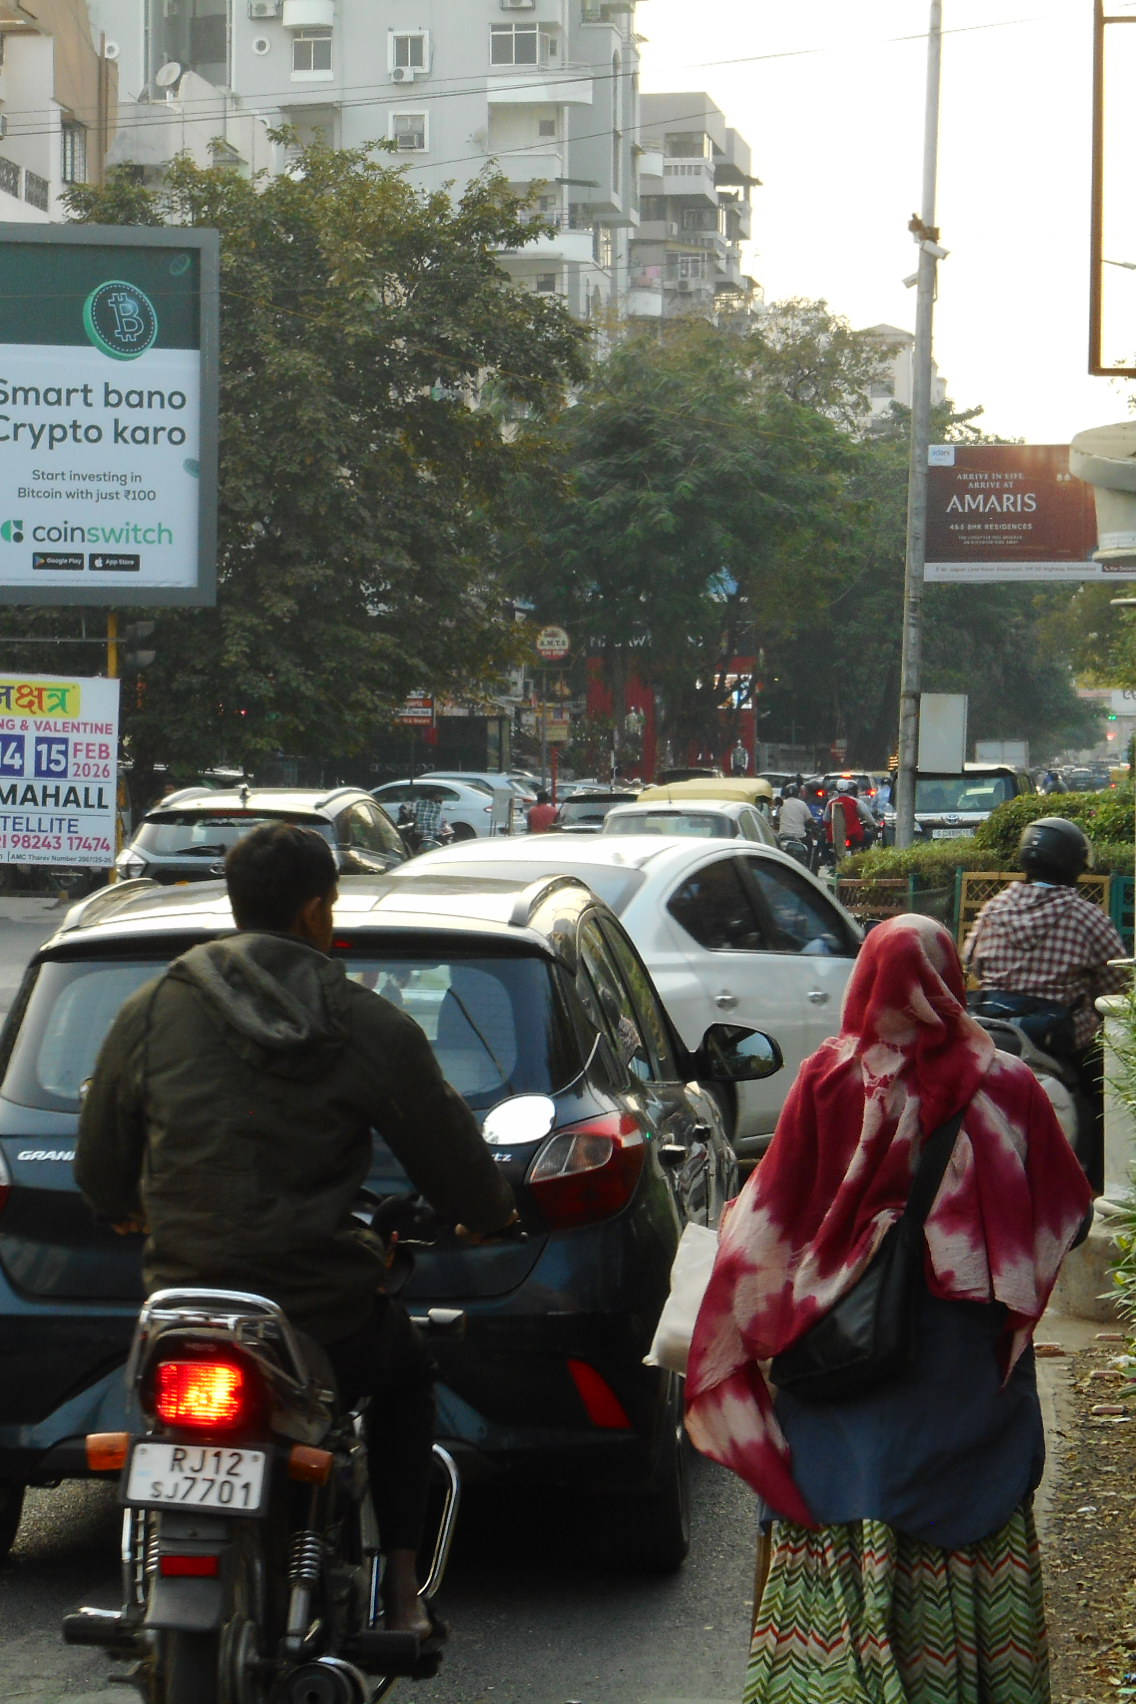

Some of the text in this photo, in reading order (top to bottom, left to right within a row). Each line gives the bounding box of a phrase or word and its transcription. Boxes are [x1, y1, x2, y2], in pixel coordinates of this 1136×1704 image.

[104, 382, 187, 410] bano
[114, 418, 186, 446] karo
[32, 469, 142, 486] Start investing in
[17, 487, 157, 503] Bitcoin with just ₹100
[946, 493, 1037, 513] AMARIS
[32, 519, 173, 544] coinswitch
[46, 557, 82, 566] Google Play
[20, 720, 29, 731] &
[34, 720, 113, 735] VALENTINE
[37, 744, 66, 772] 15
[73, 742, 110, 760] FEB
[73, 763, 111, 778] 2026
[11, 834, 62, 851] 98243
[67, 836, 111, 852] 17474
[169, 1447, 243, 1477] RJ12
[150, 1475, 253, 1507] SJ7701
